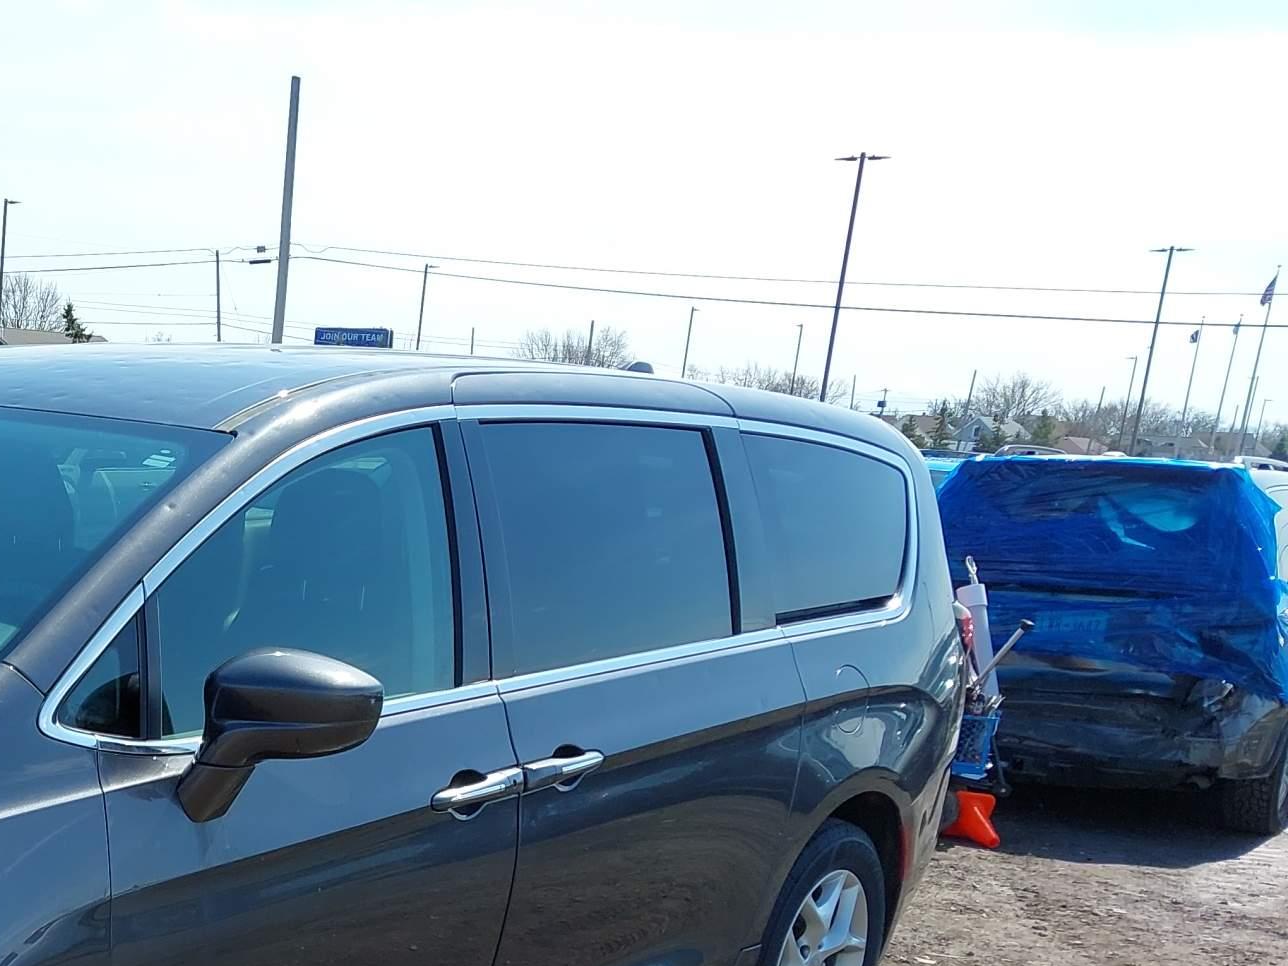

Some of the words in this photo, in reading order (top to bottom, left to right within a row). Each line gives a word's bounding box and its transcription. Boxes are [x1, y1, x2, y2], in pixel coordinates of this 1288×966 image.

[320, 331, 340, 341] JOIN
[342, 332, 359, 341] OUR
[360, 333, 385, 342] TEAM
